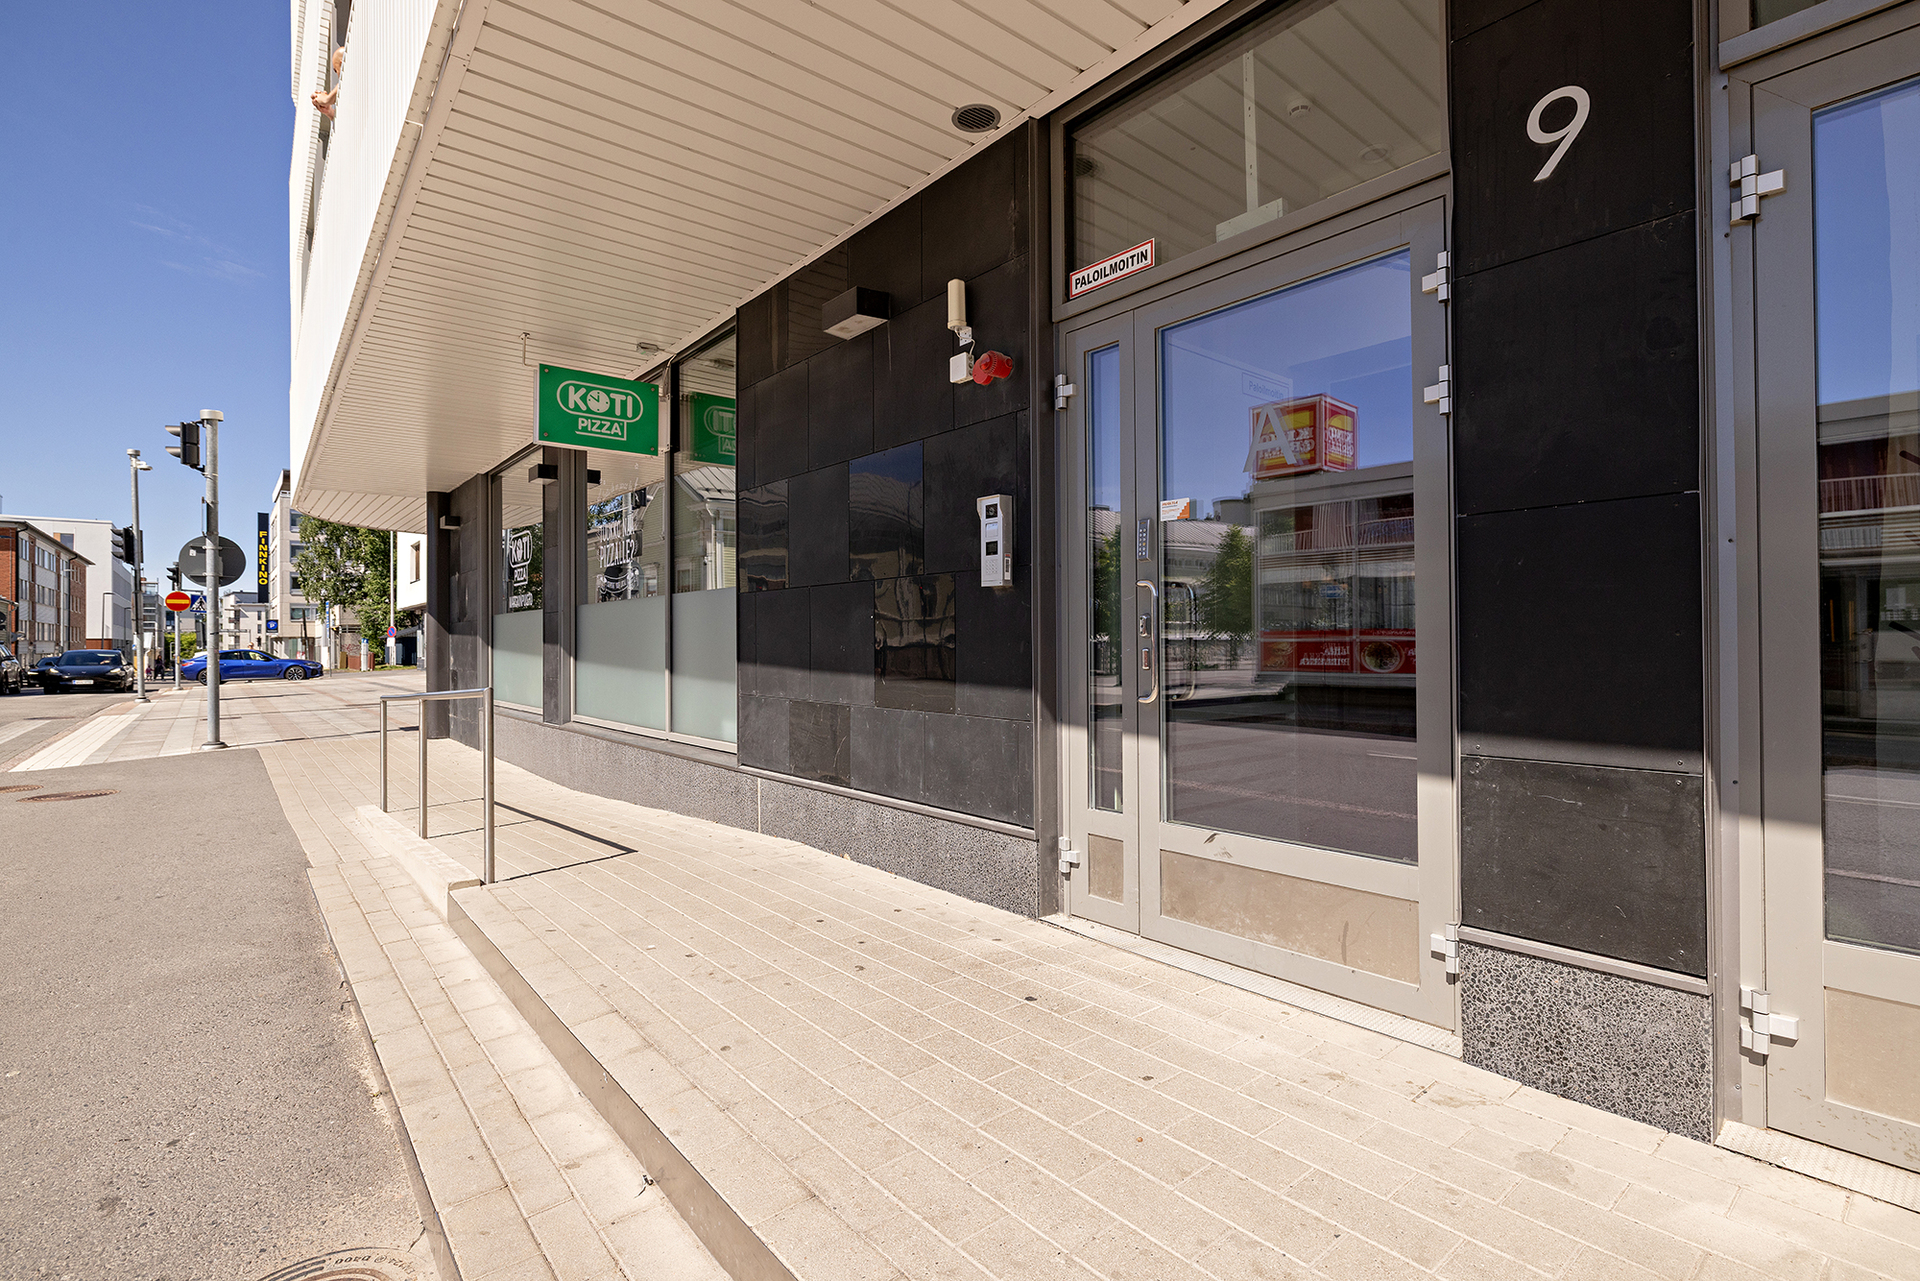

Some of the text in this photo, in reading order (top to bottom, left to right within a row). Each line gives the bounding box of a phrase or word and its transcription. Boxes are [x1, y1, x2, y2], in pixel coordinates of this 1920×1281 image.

[1526, 85, 1591, 182] 9
[1074, 249, 1148, 290] PALOILMOITIN
[568, 385, 633, 418] KOTI
[578, 417, 622, 436] PIZZA
[1242, 404, 1297, 473] A
[258, 531, 268, 584] FINNKINO
[511, 535, 530, 563] KOTI
